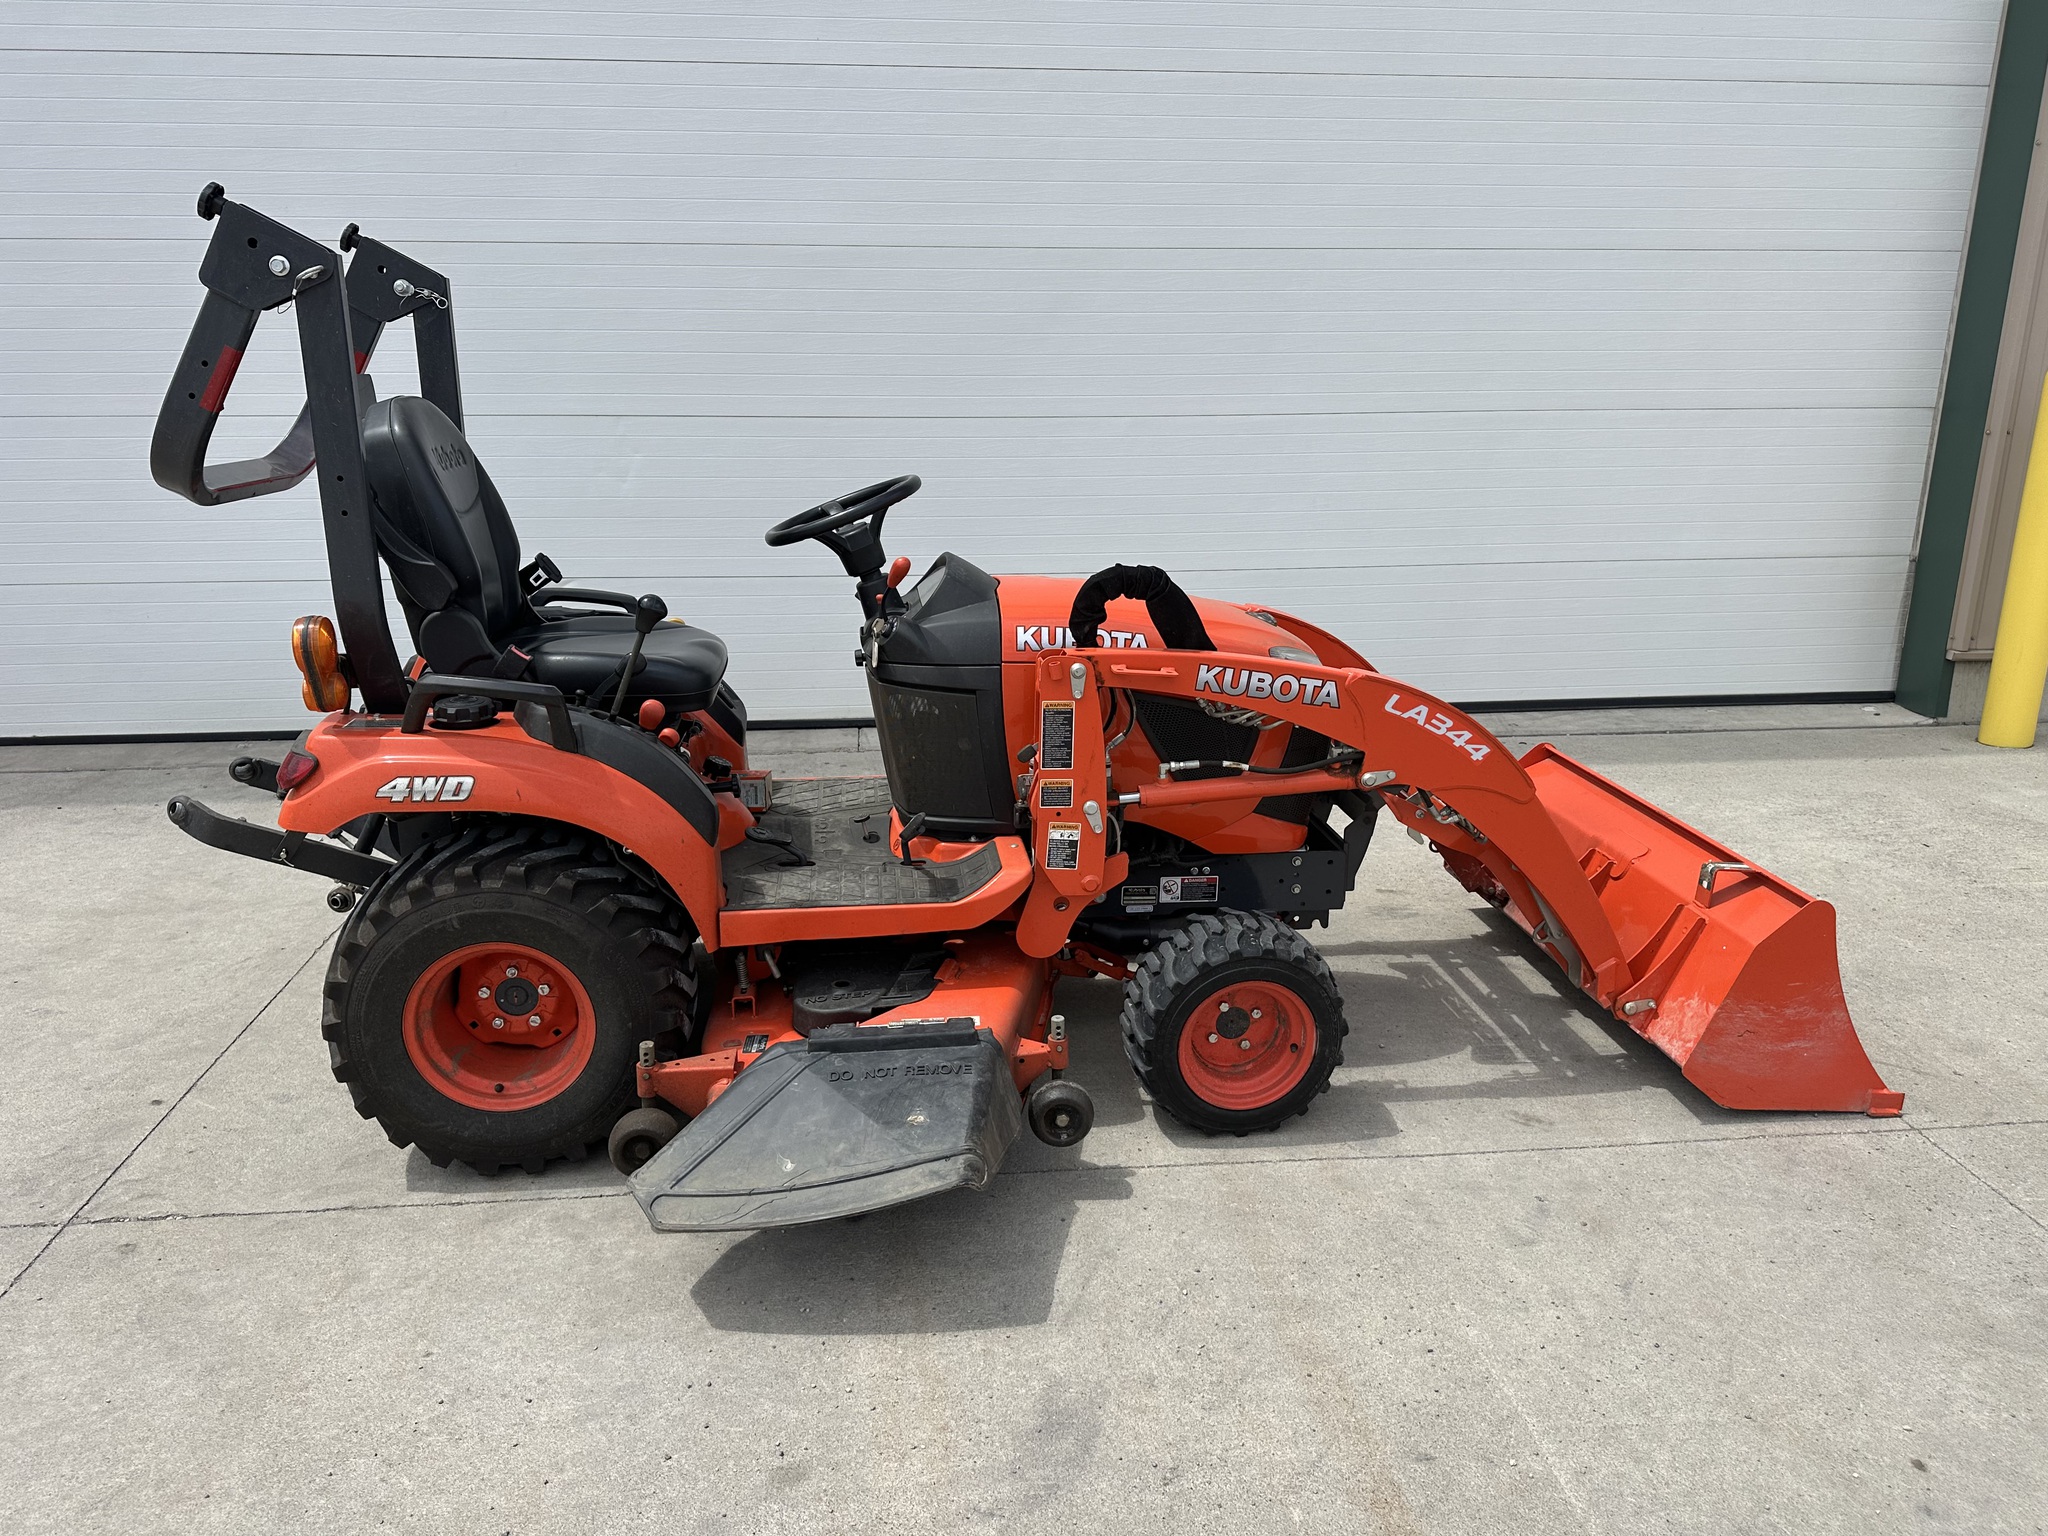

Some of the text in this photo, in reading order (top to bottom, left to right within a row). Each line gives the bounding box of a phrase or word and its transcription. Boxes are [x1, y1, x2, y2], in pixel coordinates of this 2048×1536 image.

[1195, 663, 1340, 709] KUBOTA
[1384, 693, 1491, 761] LA344
[375, 774, 476, 803] 4WD
[805, 989, 873, 1005] NO STEP
[829, 1064, 974, 1083] DO NOT REMOVE
